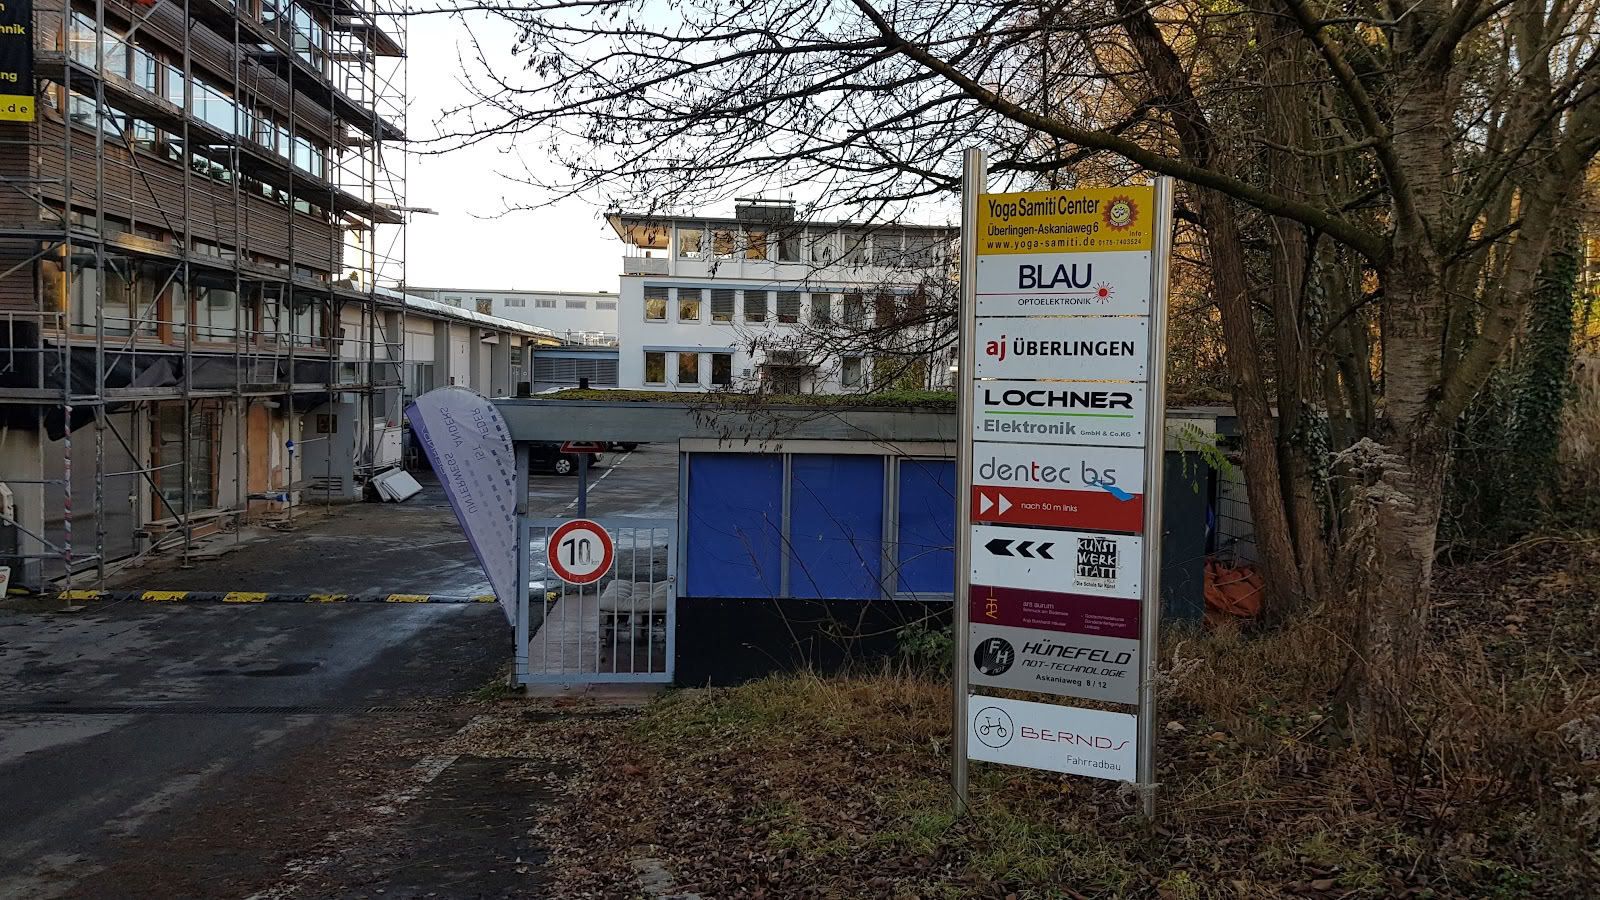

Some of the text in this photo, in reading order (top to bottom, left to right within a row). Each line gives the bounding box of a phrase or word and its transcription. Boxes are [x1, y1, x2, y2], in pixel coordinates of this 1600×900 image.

[988, 196, 1100, 221] Yoga Samiti Center
[987, 222, 1099, 237] Überlingen-Askaniaweg 6
[987, 237, 1095, 250] www.yoga-samiti.de
[1019, 263, 1092, 289] BLAU
[986, 335, 1134, 361] aj ÜBERLINGEN
[984, 389, 1134, 410] LOCHNER
[984, 419, 1076, 435] Elektronik
[979, 456, 1116, 486] dentec bs
[563, 538, 590, 565] 10
[1078, 538, 1116, 552] KUNST
[1078, 552, 1116, 565] WERK
[1078, 565, 1116, 578] STATT
[1022, 639, 1131, 665] HÜNEFELD
[1036, 674, 1082, 686] Askaniaweg
[1021, 727, 1129, 750] BERNDS
[1066, 755, 1121, 771] Fahrradbau
